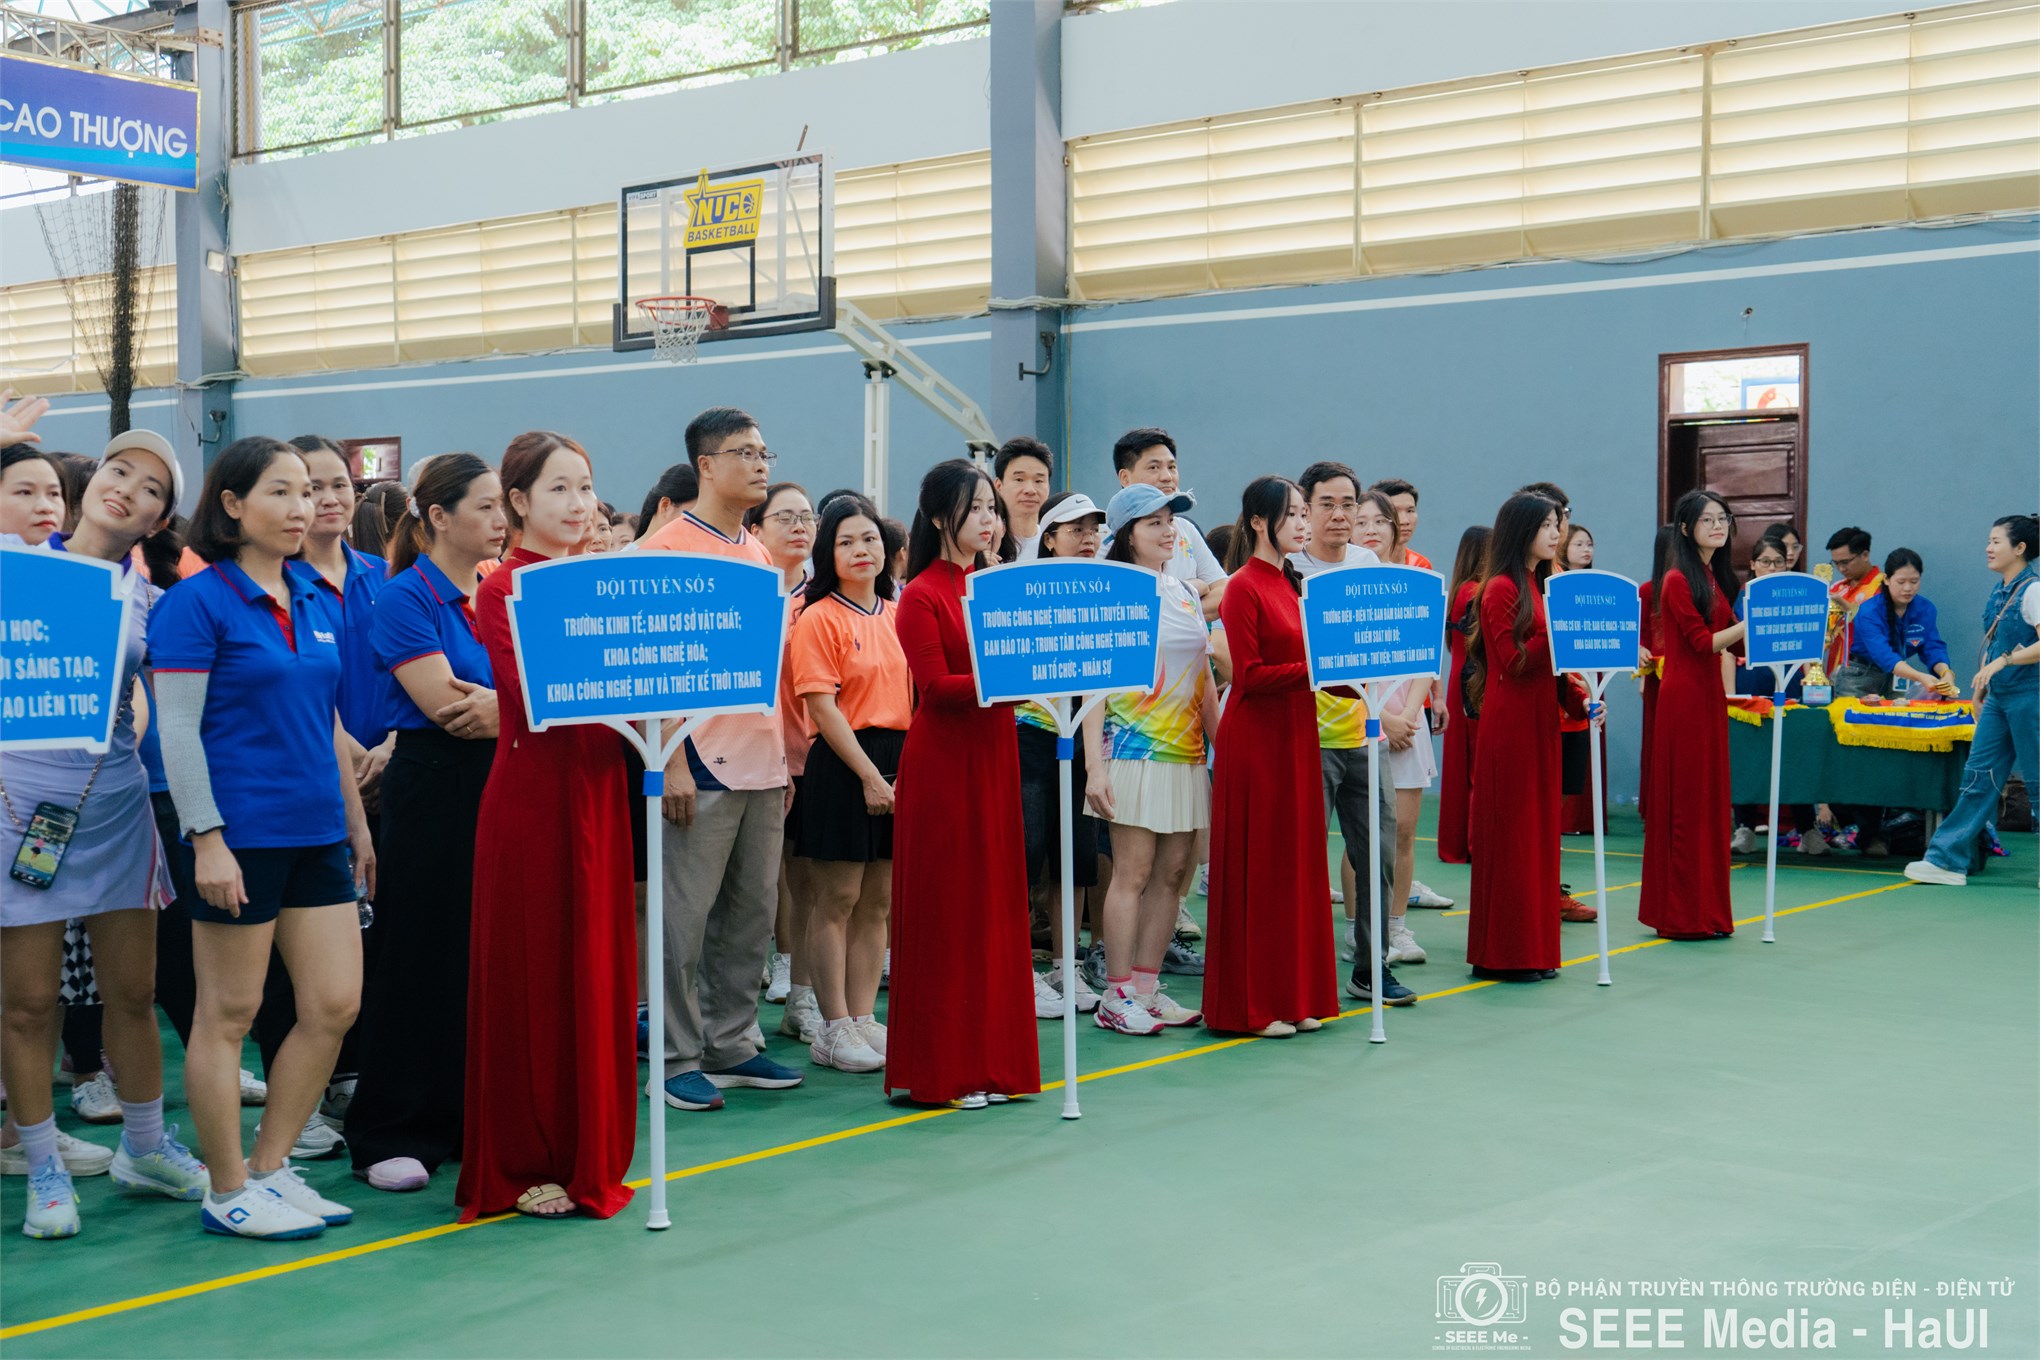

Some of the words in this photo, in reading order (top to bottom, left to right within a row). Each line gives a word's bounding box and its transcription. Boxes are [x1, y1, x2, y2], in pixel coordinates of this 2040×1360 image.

[0, 98, 62, 139] CAO
[70, 111, 188, 158] THƯỢNG
[687, 222, 755, 242] BASKETBALL
[596, 578, 625, 599] ĐỘI
[630, 575, 682, 595] TUYỂN
[685, 573, 704, 593] SỐ
[707, 577, 715, 592] 5
[1025, 580, 1046, 598] ĐỘI
[1089, 577, 1103, 594] SỐ
[1105, 581, 1111, 593] 4
[1345, 583, 1360, 598] ĐỘI
[1403, 582, 1408, 594] 3
[564, 613, 604, 636] TRƯỜNG
[606, 616, 630, 635] KINH
[632, 610, 646, 635] TẾ;
[648, 614, 667, 633] BAN
[669, 613, 682, 632] CƠ
[684, 608, 696, 631] SỞ
[698, 609, 715, 634] VẬT
[716, 605, 742, 631] CHẤT;
[1013, 607, 1032, 626] CÔNG
[1054, 605, 1077, 625] THÔNG
[1078, 608, 1089, 623] TIN
[10, 619, 49, 646] HỌC;
[984, 640, 1000, 656] BAN
[1016, 639, 1030, 658] TẠO
[1036, 637, 1059, 653] TRUNG
[1059, 633, 1075, 652] TÂM
[1076, 632, 1094, 650] CÔNG
[604, 648, 630, 666] KHOA
[632, 643, 658, 664] CÔNG
[660, 641, 685, 666] NGHỆ
[687, 640, 708, 663] HÓA;
[15, 653, 60, 680] SÁNG
[63, 656, 99, 682] TẠO;
[1032, 664, 1047, 681] BAN
[547, 683, 574, 702] KHOA
[576, 678, 604, 700] CÔNG
[606, 675, 632, 700] NGHỆ
[634, 678, 654, 696] MAY
[656, 673, 669, 694] VÀ
[671, 669, 696, 693] THIẾT
[698, 669, 710, 691] KẾ
[711, 668, 731, 690] THỜI
[733, 670, 762, 688] TRANG
[0, 696, 25, 723] ẠO
[29, 691, 65, 717] LIÊN
[68, 693, 99, 719] TỤC
